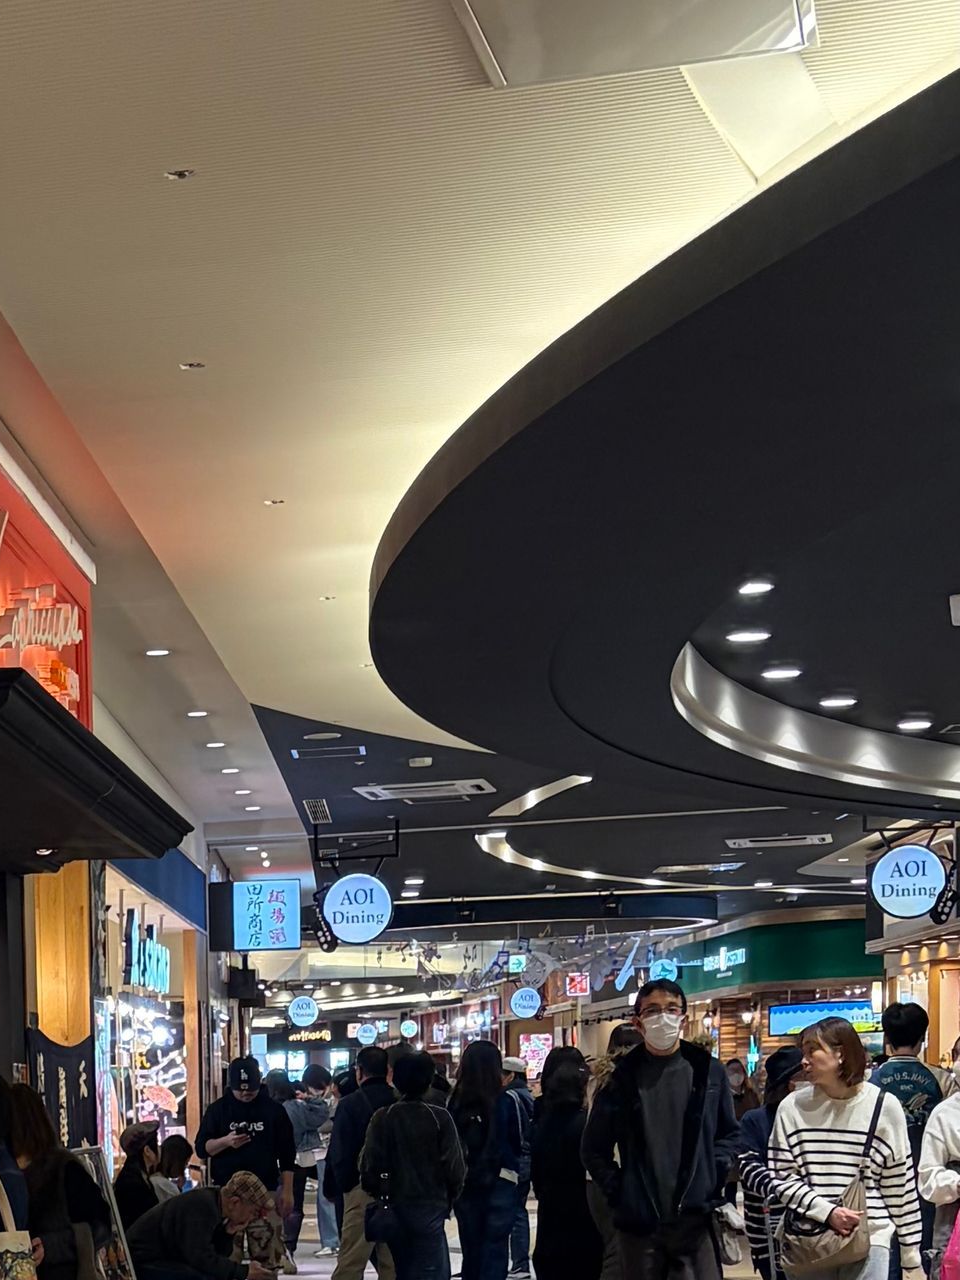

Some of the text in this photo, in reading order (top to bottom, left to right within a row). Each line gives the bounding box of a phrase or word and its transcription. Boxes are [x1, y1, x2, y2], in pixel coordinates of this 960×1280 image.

[889, 860, 928, 878] AOI
[339, 888, 376, 906] AOI
[880, 882, 937, 900] Dining
[246, 883, 264, 947] 田所商店
[332, 910, 385, 926] Dining
[518, 994, 534, 1002] AOI
[296, 1002, 311, 1011] AOI
[514, 1002, 537, 1011] Dining
[293, 1011, 315, 1019] Dining
